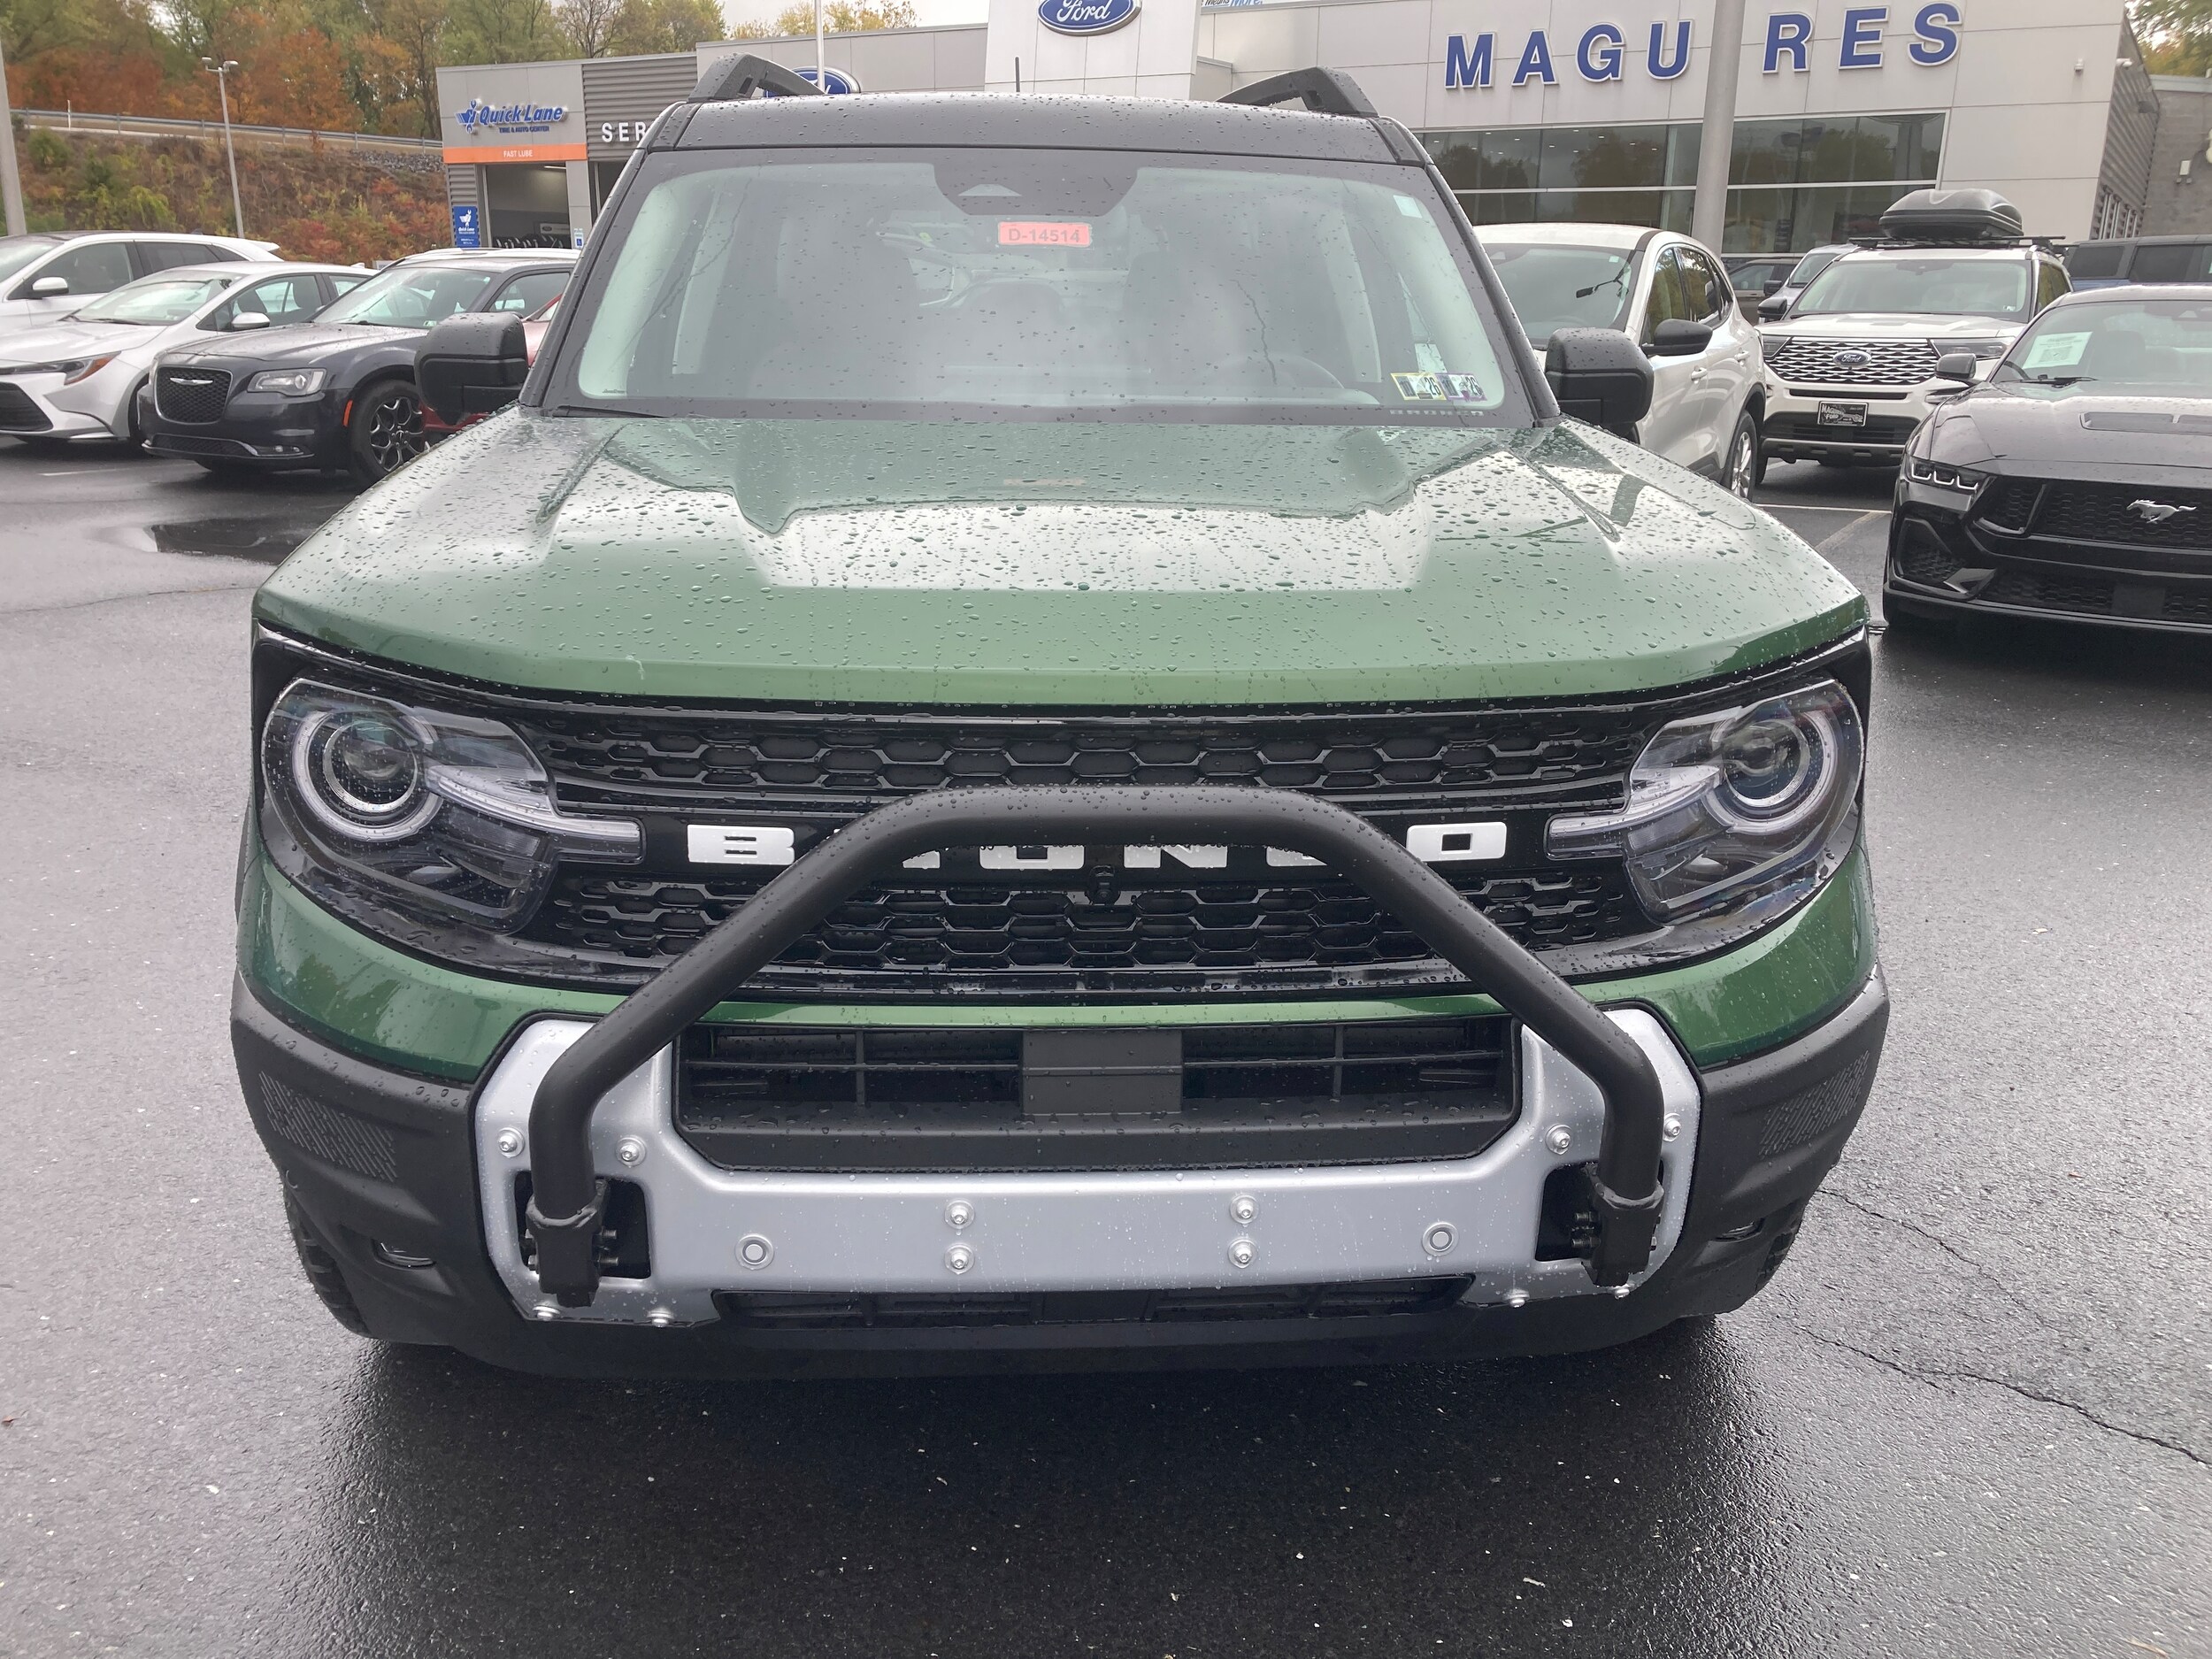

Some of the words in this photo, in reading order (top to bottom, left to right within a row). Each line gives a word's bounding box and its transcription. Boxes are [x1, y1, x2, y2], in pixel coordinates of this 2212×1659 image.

[1056, 0, 1112, 22] Ford
[1444, 2, 1963, 89] MAGURES
[479, 104, 521, 125] Quick
[524, 104, 564, 123] Lane
[602, 121, 647, 142] SER
[518, 149, 533, 157] LUBE
[1008, 227, 1080, 243] D-14514
[1841, 354, 1862, 363] Ford
